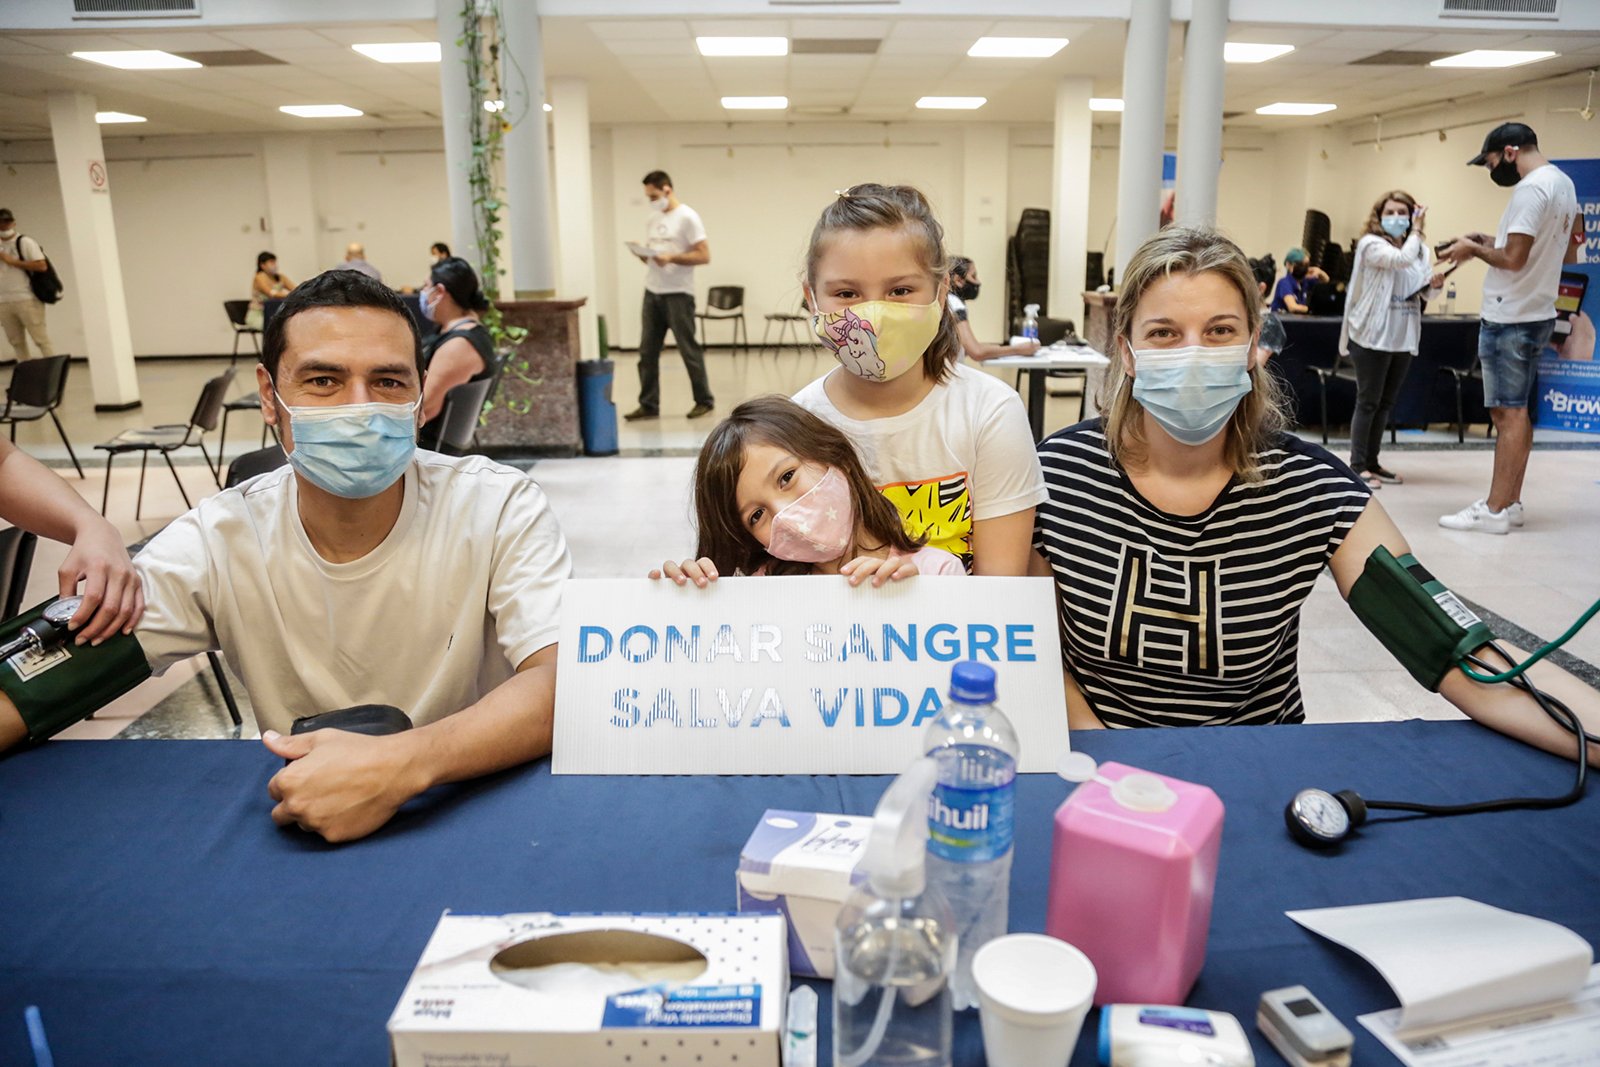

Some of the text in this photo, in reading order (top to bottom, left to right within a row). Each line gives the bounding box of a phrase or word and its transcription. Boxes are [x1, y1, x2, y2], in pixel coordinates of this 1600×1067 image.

[1576, 203, 1600, 215] AR
[577, 623, 1037, 663] DONAR SANGRE
[610, 687, 791, 728] SALVA
